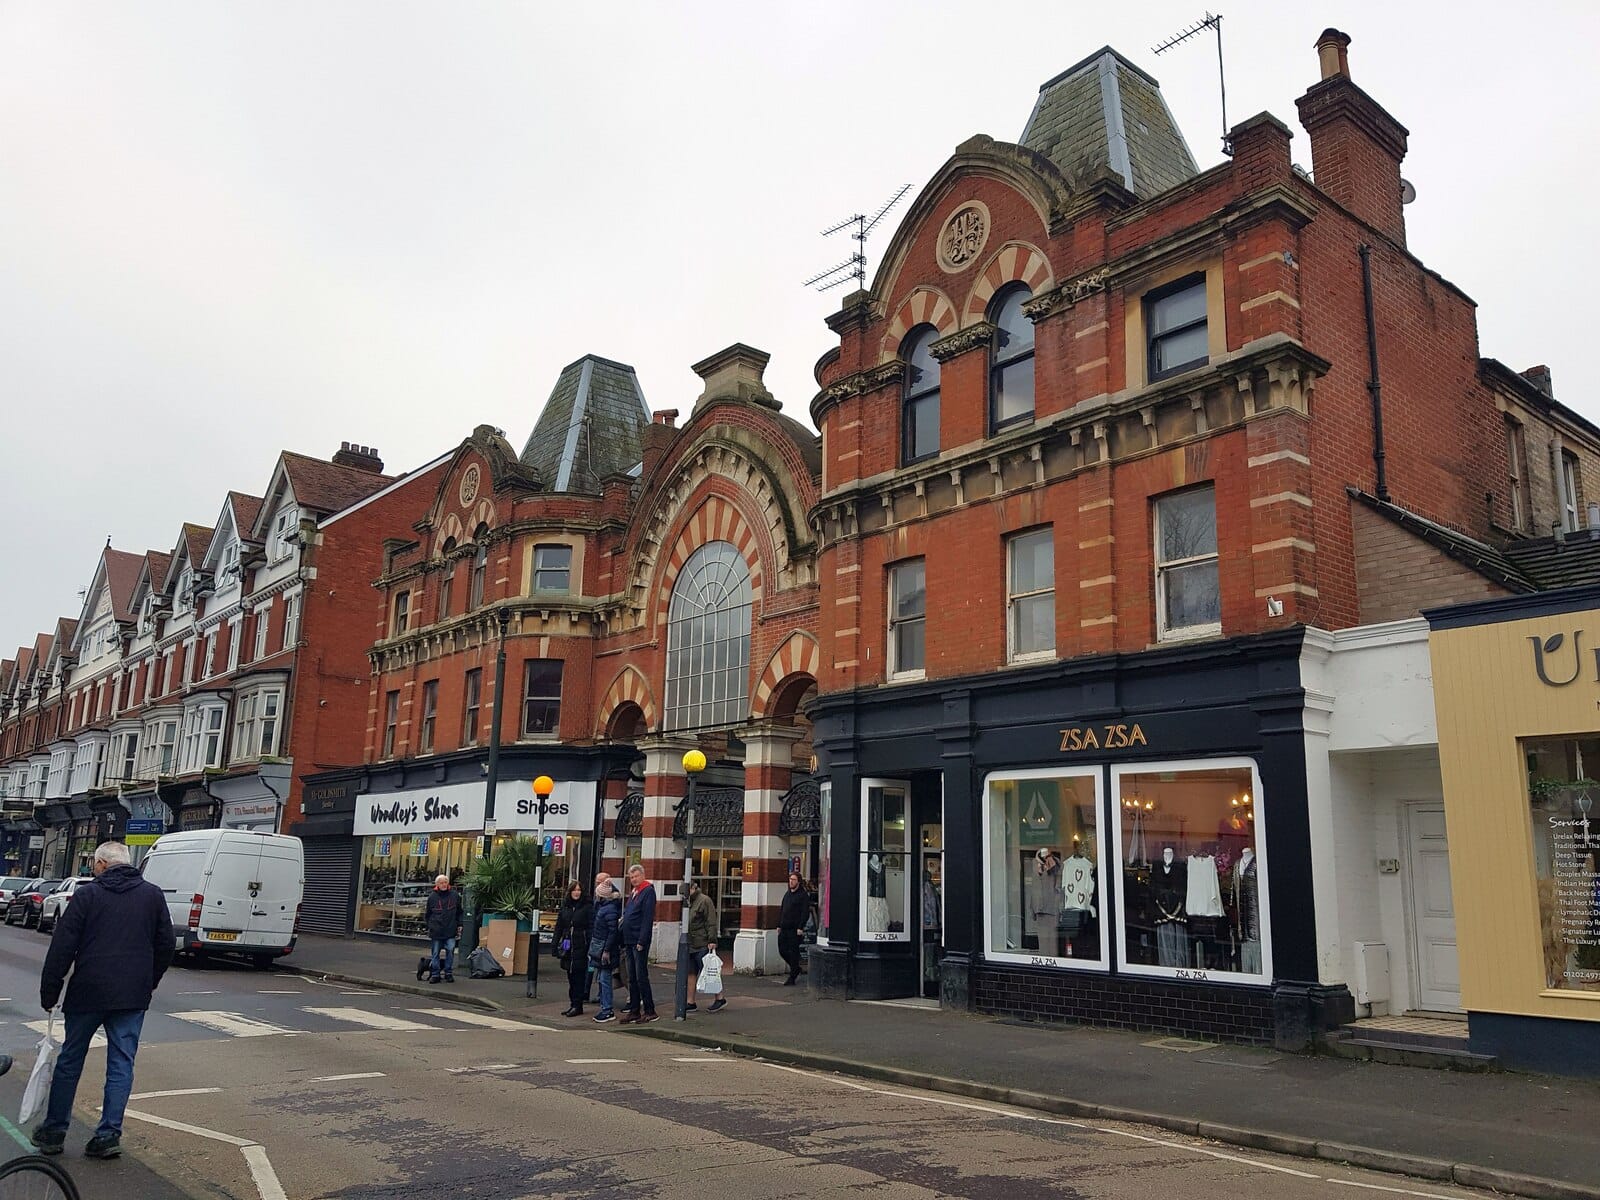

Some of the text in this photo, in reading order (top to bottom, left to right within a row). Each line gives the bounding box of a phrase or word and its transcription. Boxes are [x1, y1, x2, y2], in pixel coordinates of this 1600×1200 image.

[1059, 723, 1148, 752] ZSA ZSA
[370, 796, 459, 827] Woodley's Shoes
[516, 799, 569, 815] Shoes
[1549, 816, 1590, 828] Services
[1555, 851, 1592, 859] Deep Tissue
[1556, 870, 1581, 878] Couples
[1561, 919, 1594, 927] Pregnancy
[1561, 927, 1593, 936] Signature
[1575, 937, 1598, 946] Luxury
[1031, 956, 1058, 968] ZSA ZSA
[1176, 969, 1209, 981] ZSA ZSA
